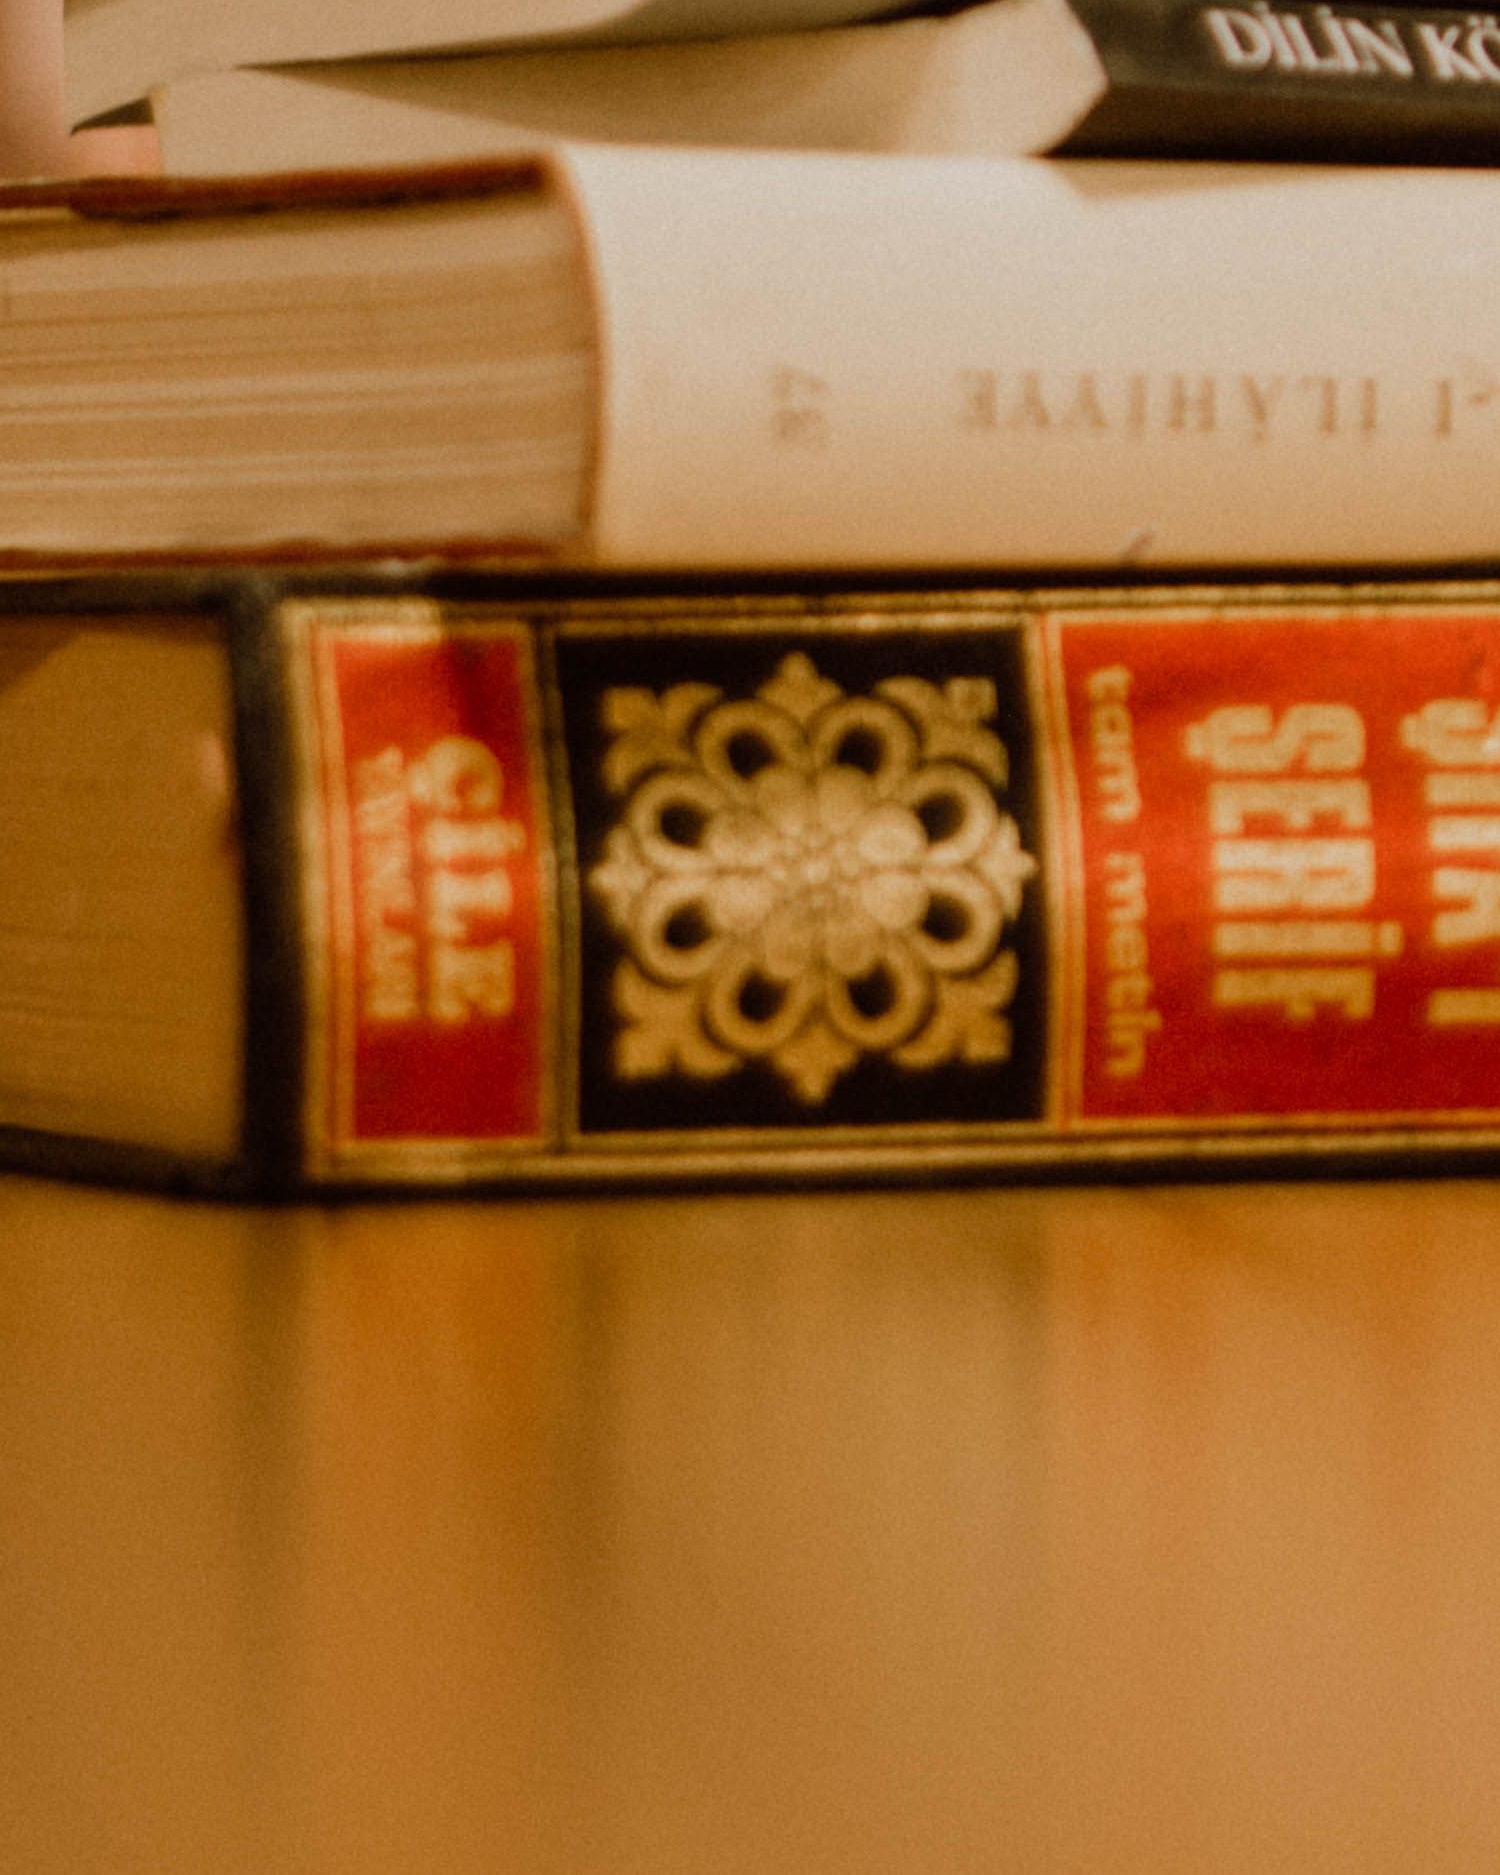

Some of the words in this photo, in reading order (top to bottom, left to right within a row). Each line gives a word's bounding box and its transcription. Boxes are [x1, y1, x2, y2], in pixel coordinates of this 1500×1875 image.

[1204, 1, 1414, 77] DİLİN
[1087, 662, 1143, 824] tam
[1183, 702, 1403, 1022] ŞERİF
[1103, 851, 1161, 1078] metin
